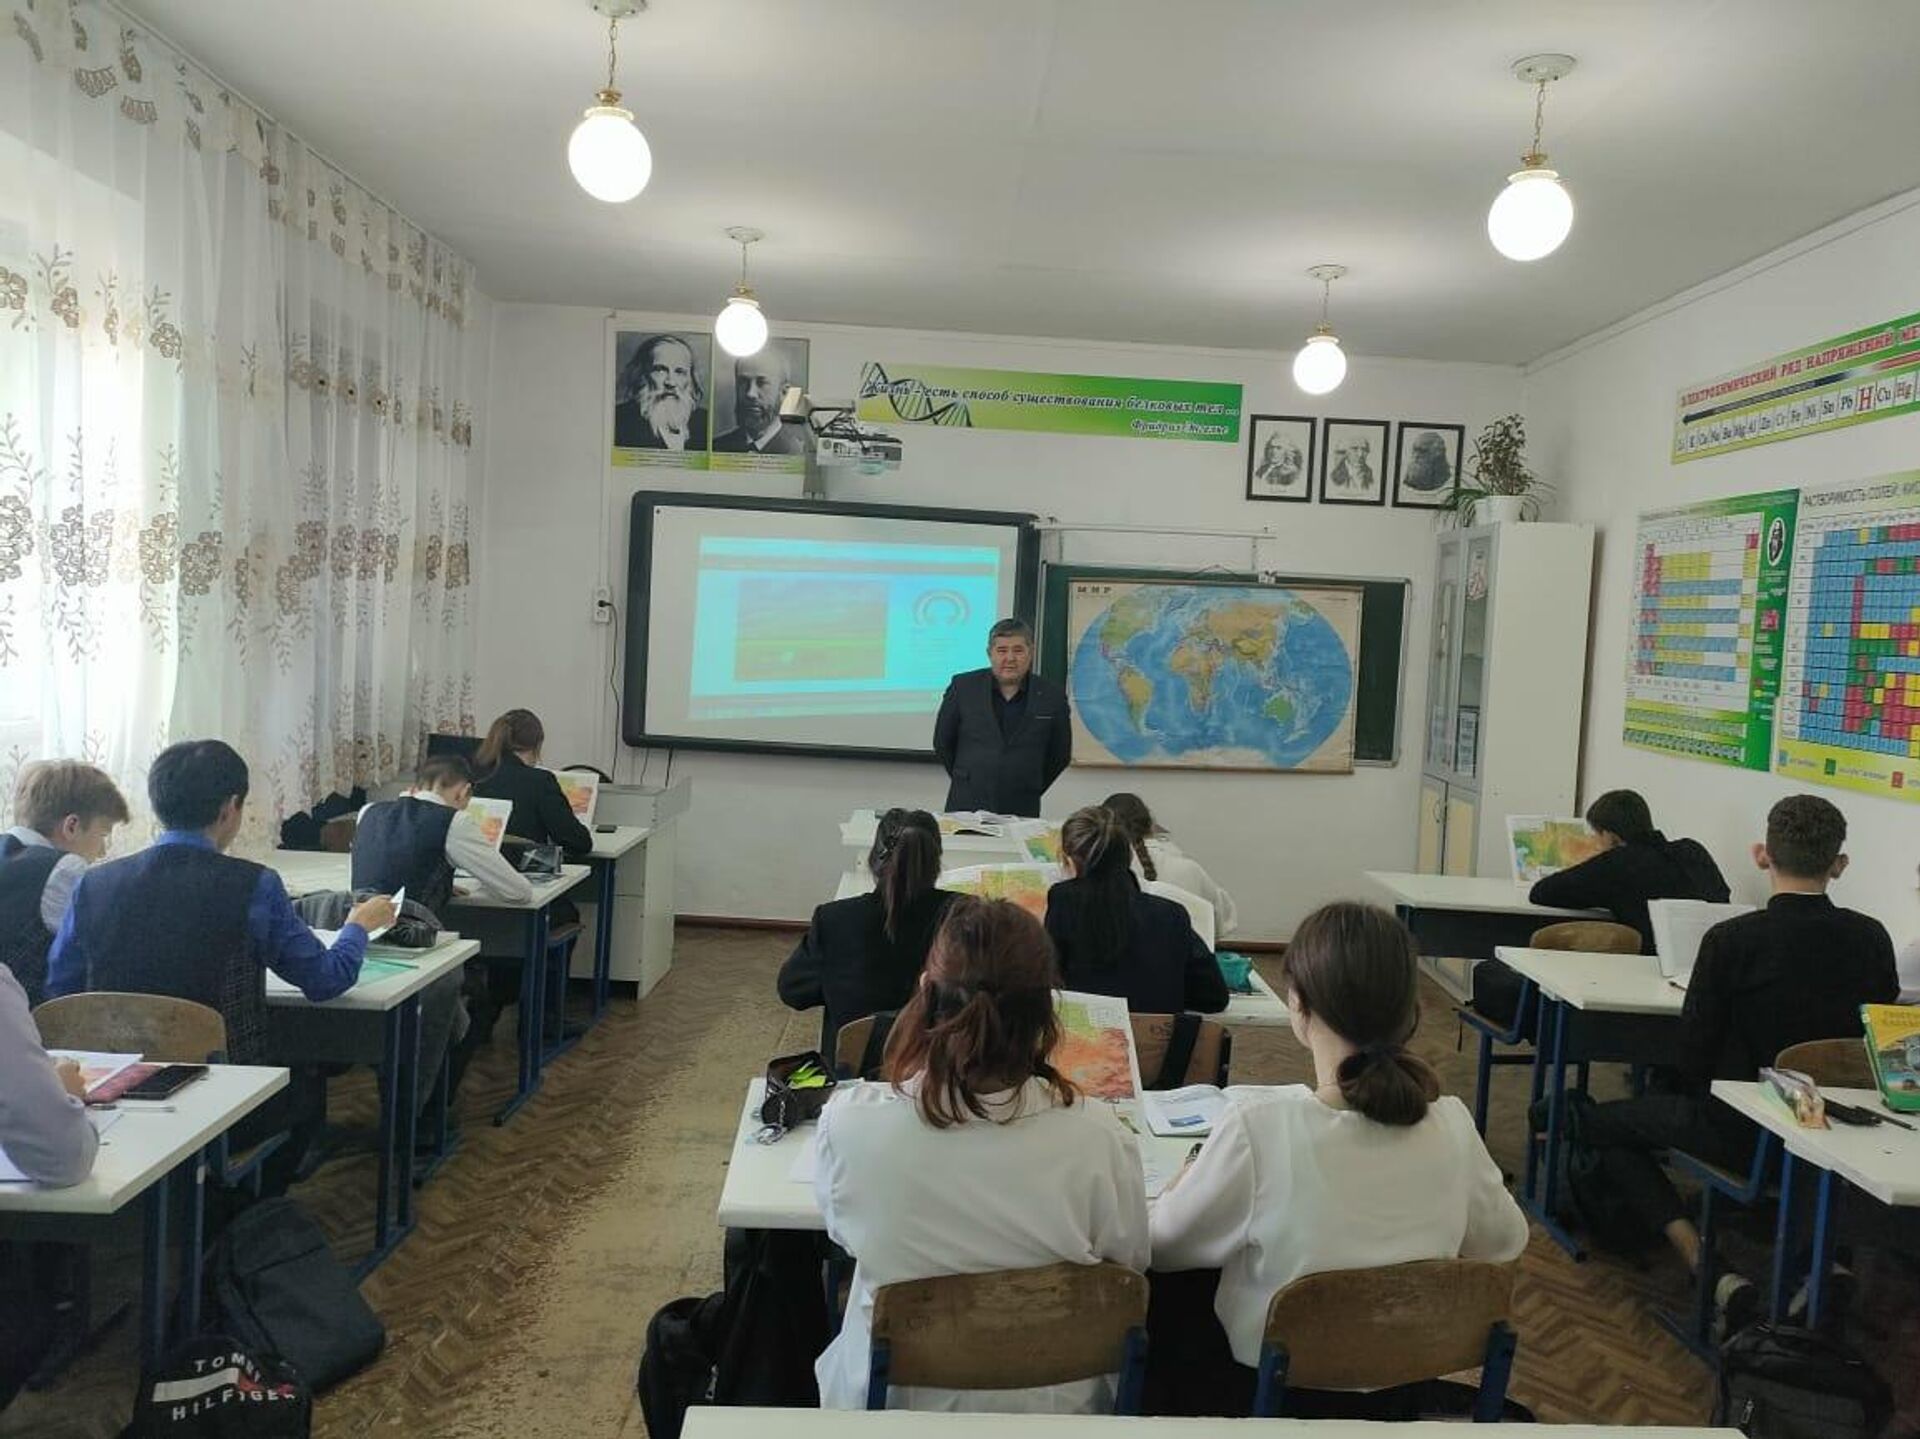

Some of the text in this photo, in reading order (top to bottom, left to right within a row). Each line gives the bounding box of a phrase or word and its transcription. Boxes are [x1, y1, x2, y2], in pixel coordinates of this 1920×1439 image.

[1781, 359, 1802, 377] РЯД
[1806, 332, 1894, 370] НАПРЯЖЕНИЙ
[924, 387, 959, 399] есть
[962, 387, 1009, 402] способ
[1013, 392, 1122, 408] существования
[1126, 395, 1191, 412] белковых
[1840, 395, 1853, 412] Pb
[1859, 386, 1874, 411] H
[1877, 386, 1892, 402] Cu
